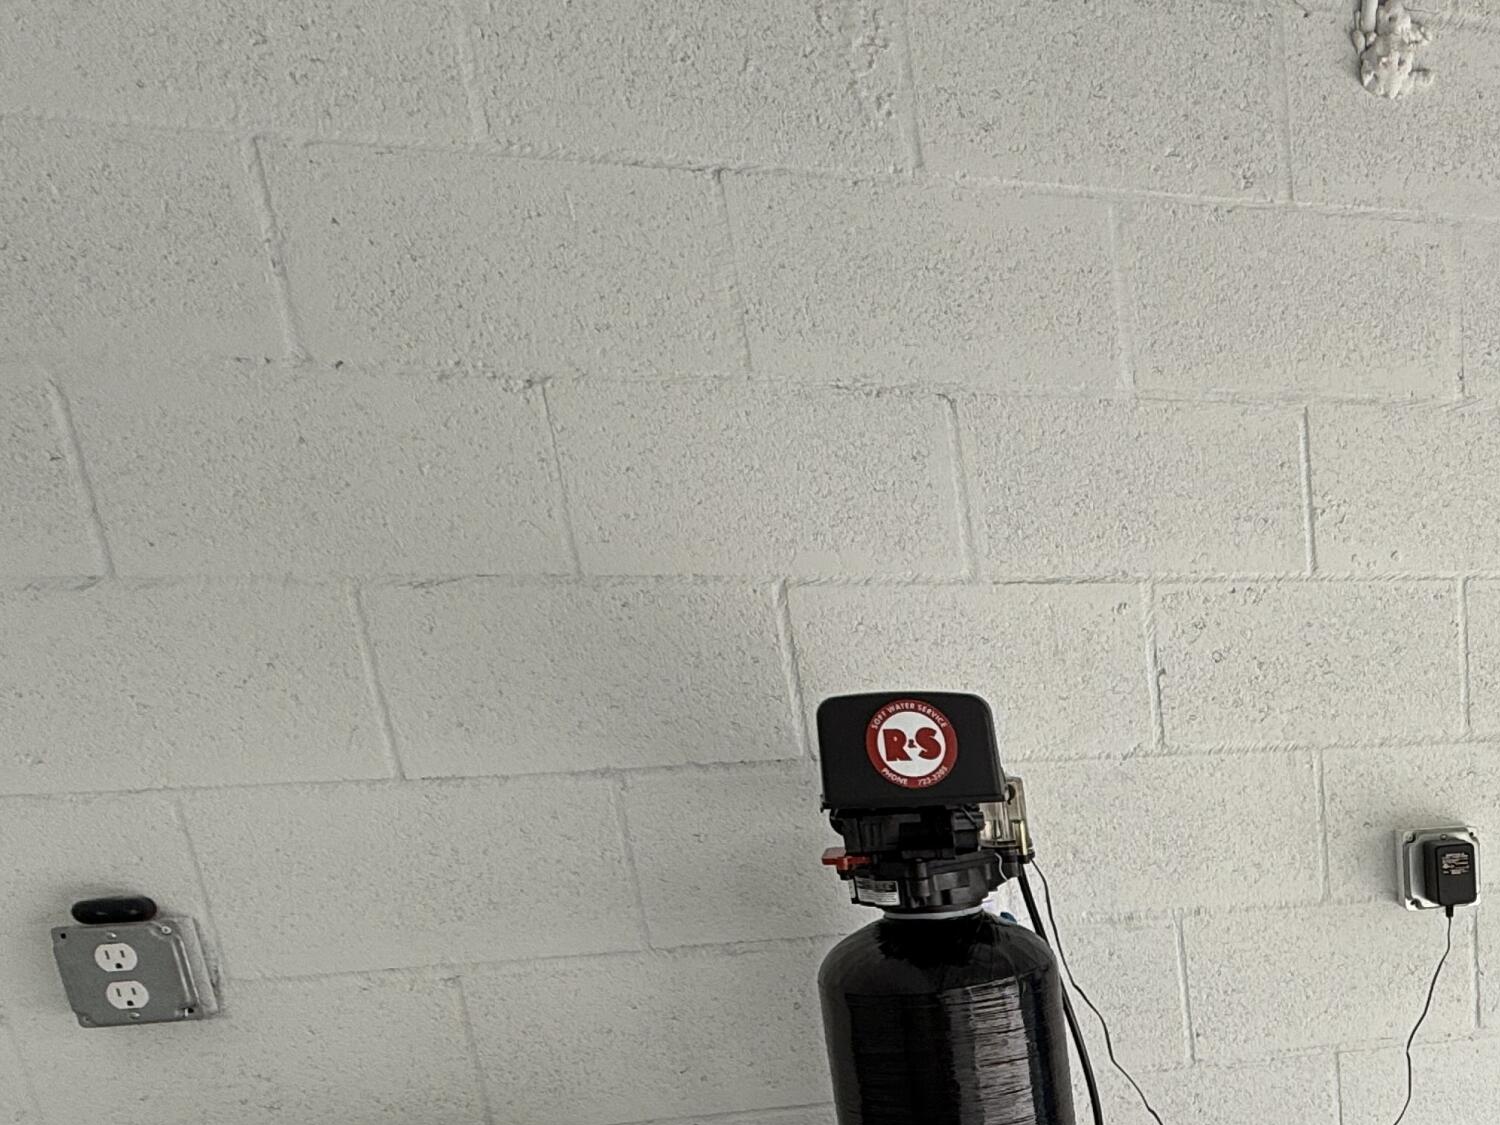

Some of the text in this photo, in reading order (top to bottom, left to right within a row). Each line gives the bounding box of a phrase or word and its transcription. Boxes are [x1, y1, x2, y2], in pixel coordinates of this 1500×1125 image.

[887, 702, 915, 713] WATER
[917, 704, 948, 728] SERVICE
[882, 727, 942, 762] R&S
[880, 767, 908, 785] PHONE
